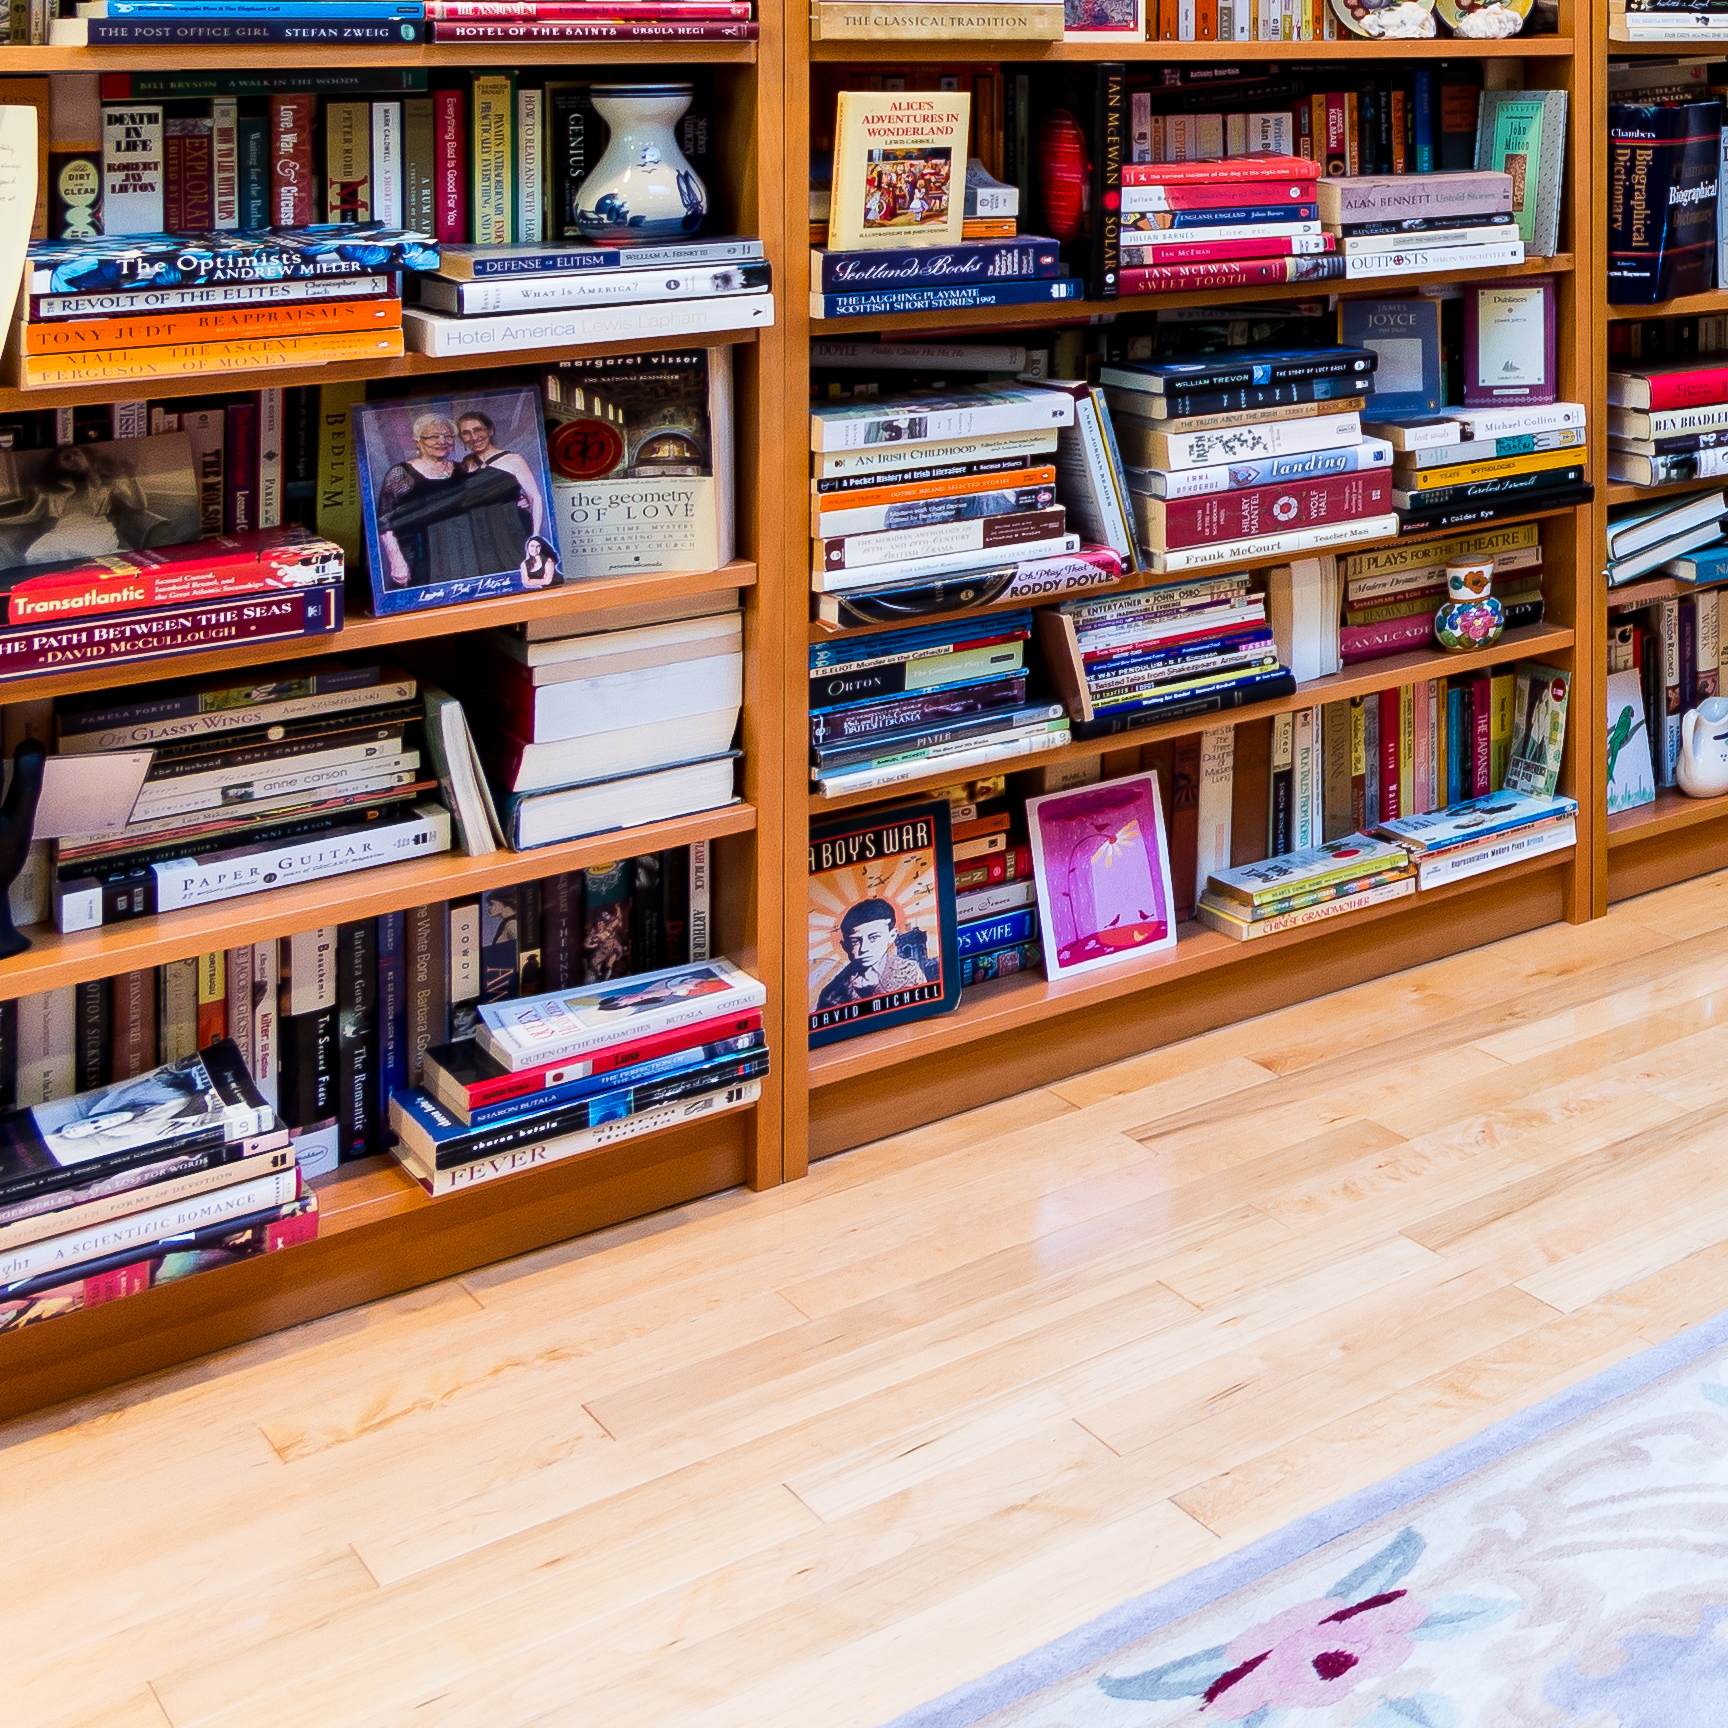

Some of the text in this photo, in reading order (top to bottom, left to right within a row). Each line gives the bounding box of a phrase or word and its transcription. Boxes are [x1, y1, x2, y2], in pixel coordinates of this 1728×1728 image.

[100, 26, 269, 39] THE POST OFFICE GIRL
[285, 27, 389, 39] STEFAN ZWEIG
[890, 102, 934, 113] ALICE'S
[862, 114, 959, 127] ADVENTURES IN
[867, 125, 955, 138] WONDERLAND
[1611, 147, 1630, 231] Dictionary
[1631, 147, 1654, 247] Biographical
[1104, 217, 1117, 276] SOLAR
[117, 252, 302, 277] The Optimists
[213, 261, 361, 281] ANDREW MILLER
[1138, 273, 1247, 290] SWEET TOOTH
[61, 284, 291, 313] REVOLT OF THE ELITES
[38, 324, 176, 345] TONY JUDT
[1271, 452, 1347, 475] landing
[571, 487, 695, 511] the geometry
[571, 503, 695, 523] OF LOVE
[1010, 571, 1113, 596] RODDY DOYLE
[16, 588, 143, 617] Transatlantic
[32, 603, 294, 652] PATH BETWEEN THE SEAS
[827, 675, 882, 695] ORTON
[824, 823, 929, 867] BOY'S WAR
[182, 843, 374, 893] PAPER GUITAR
[974, 923, 1012, 941] WIFE
[812, 985, 940, 1029] DAVID MICHELL
[450, 1147, 547, 1188] FEVER
